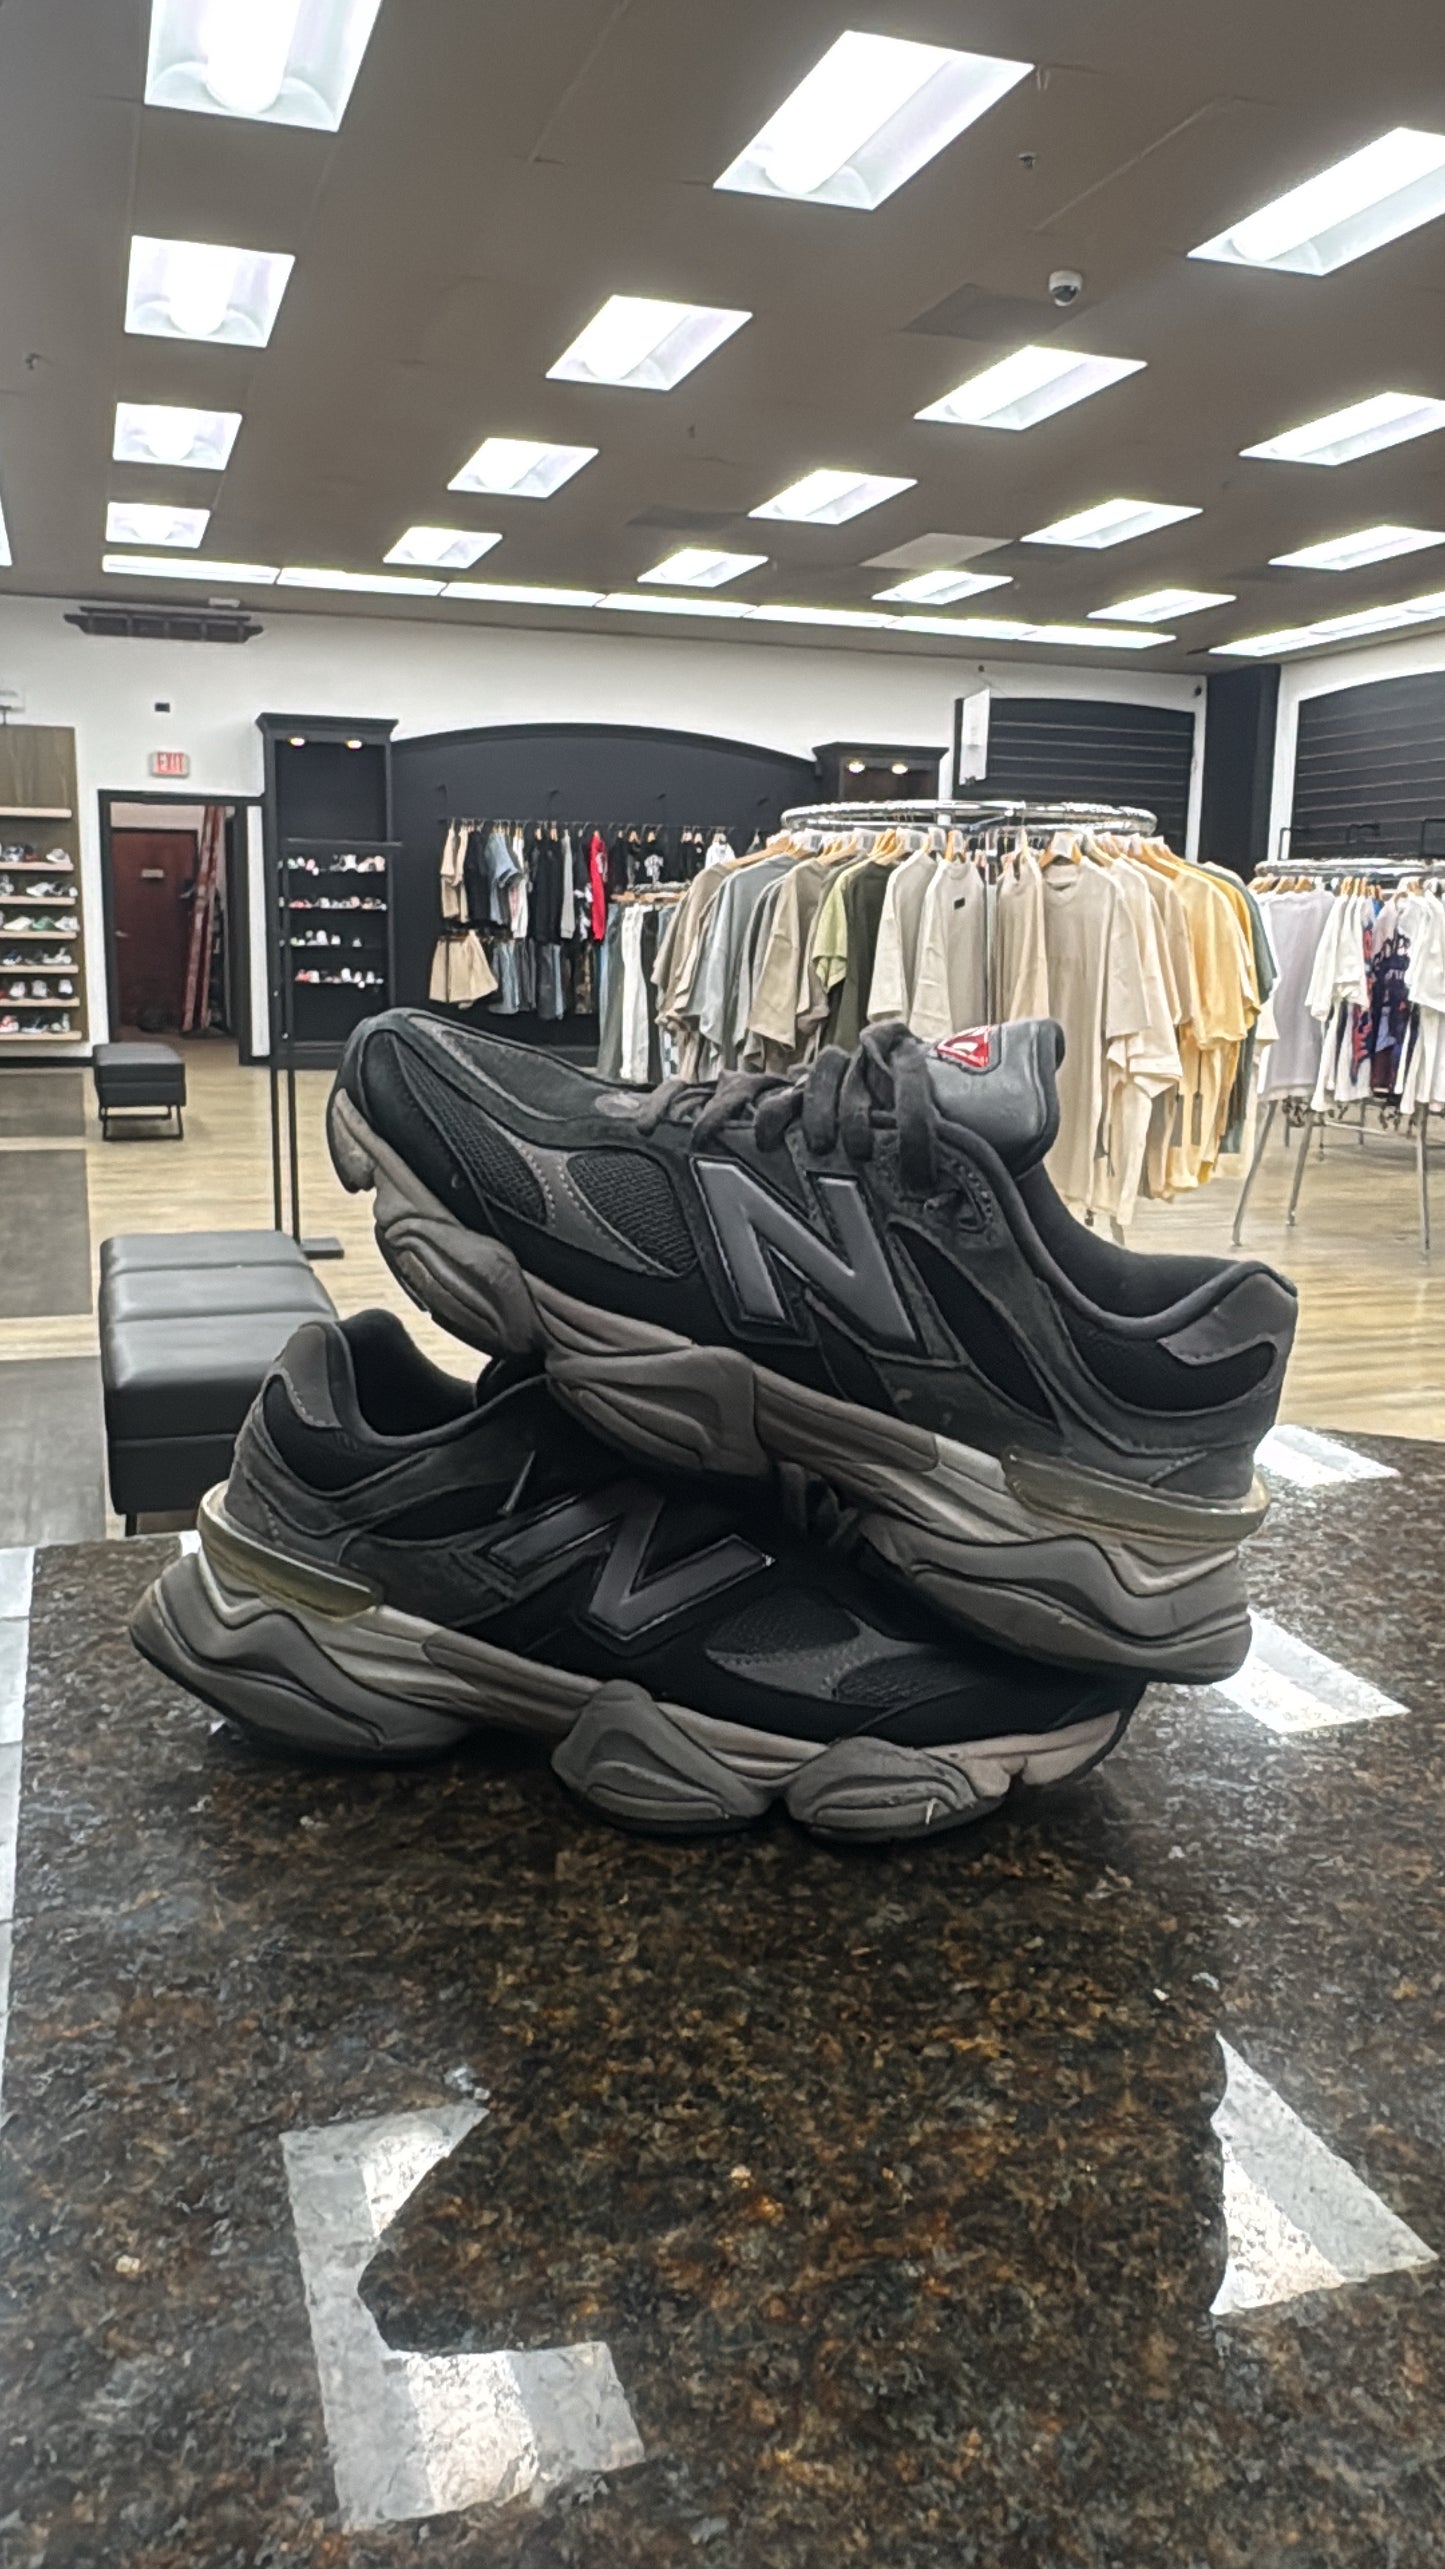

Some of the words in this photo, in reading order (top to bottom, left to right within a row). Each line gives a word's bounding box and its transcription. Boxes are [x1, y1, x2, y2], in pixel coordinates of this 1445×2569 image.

[156, 751, 185, 774] EXIT
[691, 1156, 921, 1346] N
[484, 1480, 773, 1641] N
